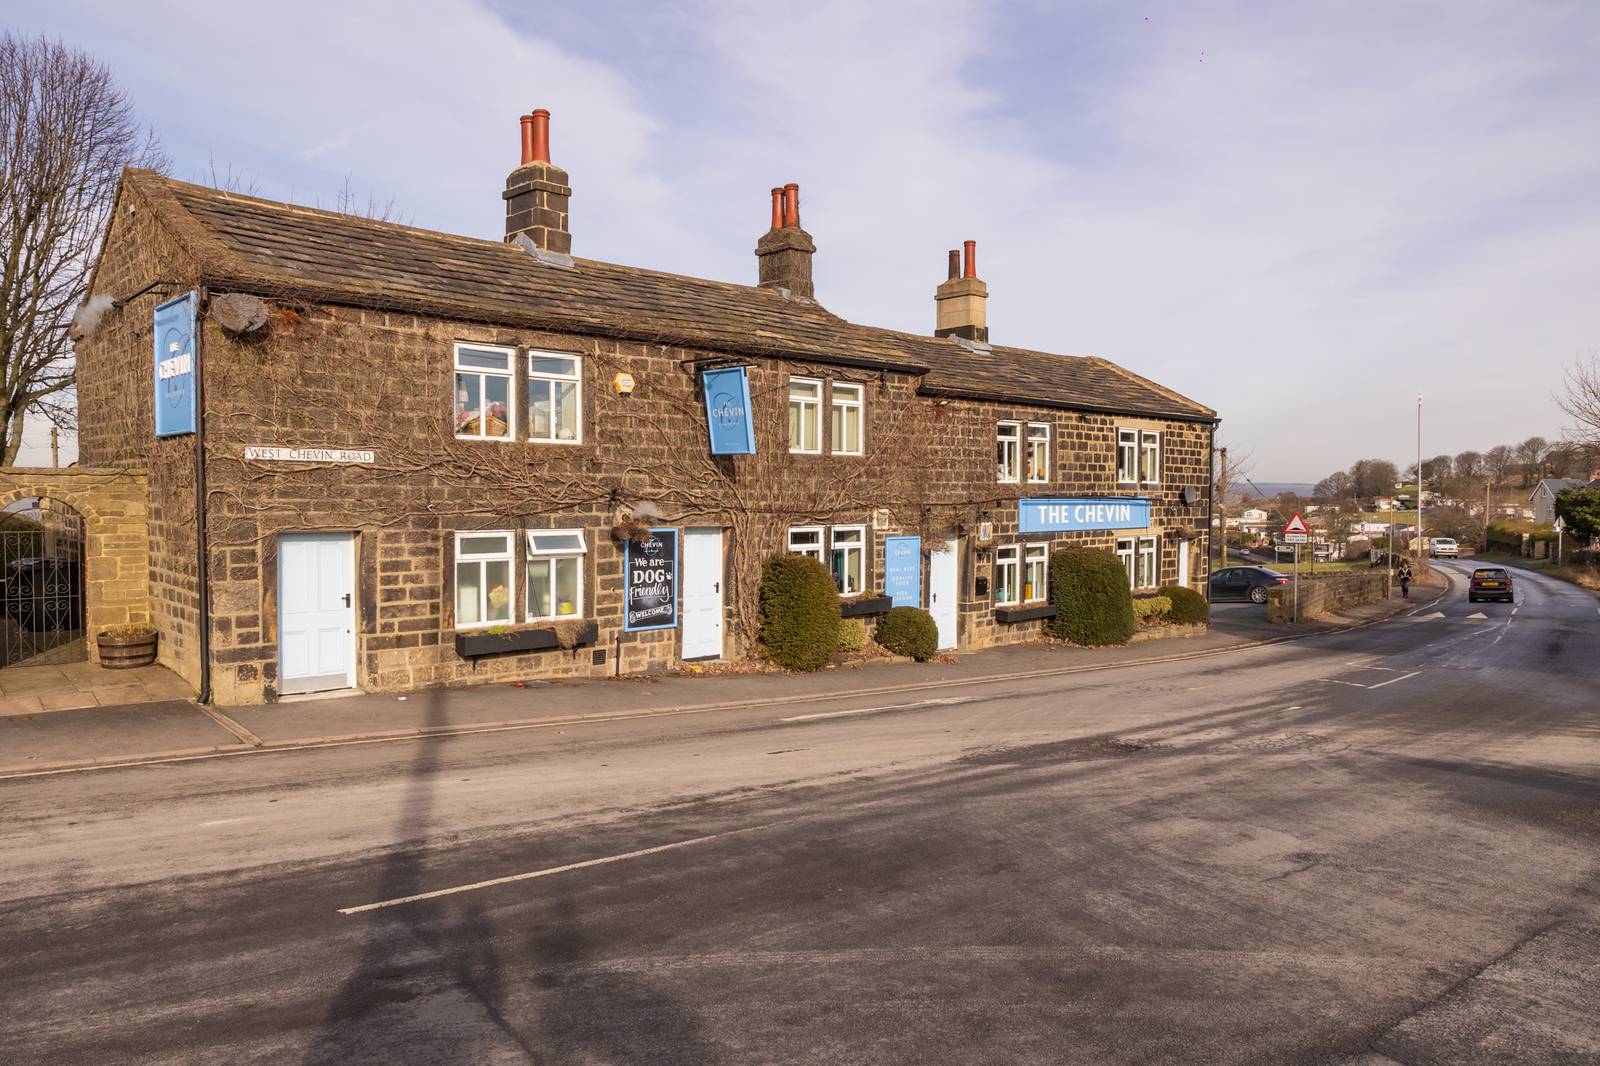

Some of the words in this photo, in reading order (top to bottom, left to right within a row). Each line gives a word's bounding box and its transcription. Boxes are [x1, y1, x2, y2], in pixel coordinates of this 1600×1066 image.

[159, 352, 191, 379] CHEVIN
[712, 407, 745, 417] CHEVIN
[248, 448, 281, 459] WEST
[289, 450, 333, 460] CHEVIN
[340, 452, 371, 462] ROAD
[1038, 505, 1069, 524] THE
[1074, 504, 1131, 523] CHEVIN
[634, 558, 648, 567] We
[649, 558, 665, 567] are
[633, 569, 665, 584] DOG
[635, 606, 665, 618] WELCOME
